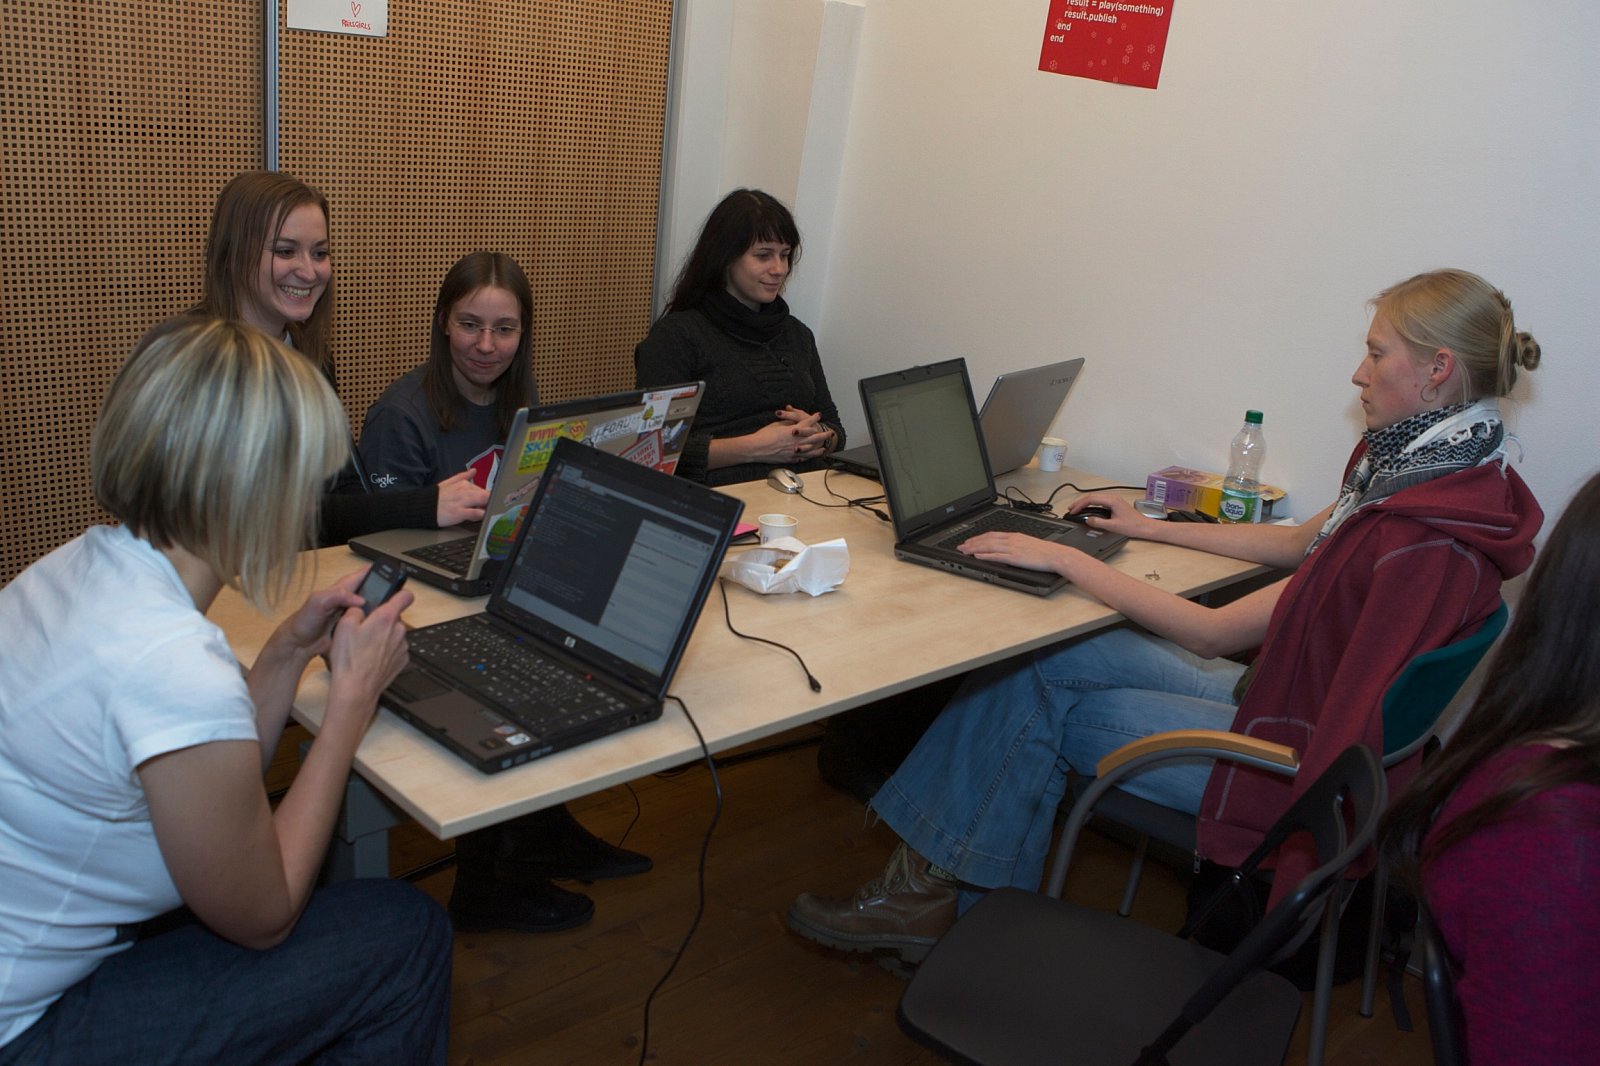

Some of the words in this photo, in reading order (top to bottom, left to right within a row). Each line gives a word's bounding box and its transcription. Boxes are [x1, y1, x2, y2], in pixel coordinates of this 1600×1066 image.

[1098, 0, 1164, 16] play(something)
[1064, 10, 1118, 24] result.publish
[1057, 22, 1071, 31] end
[1050, 34, 1065, 43] end
